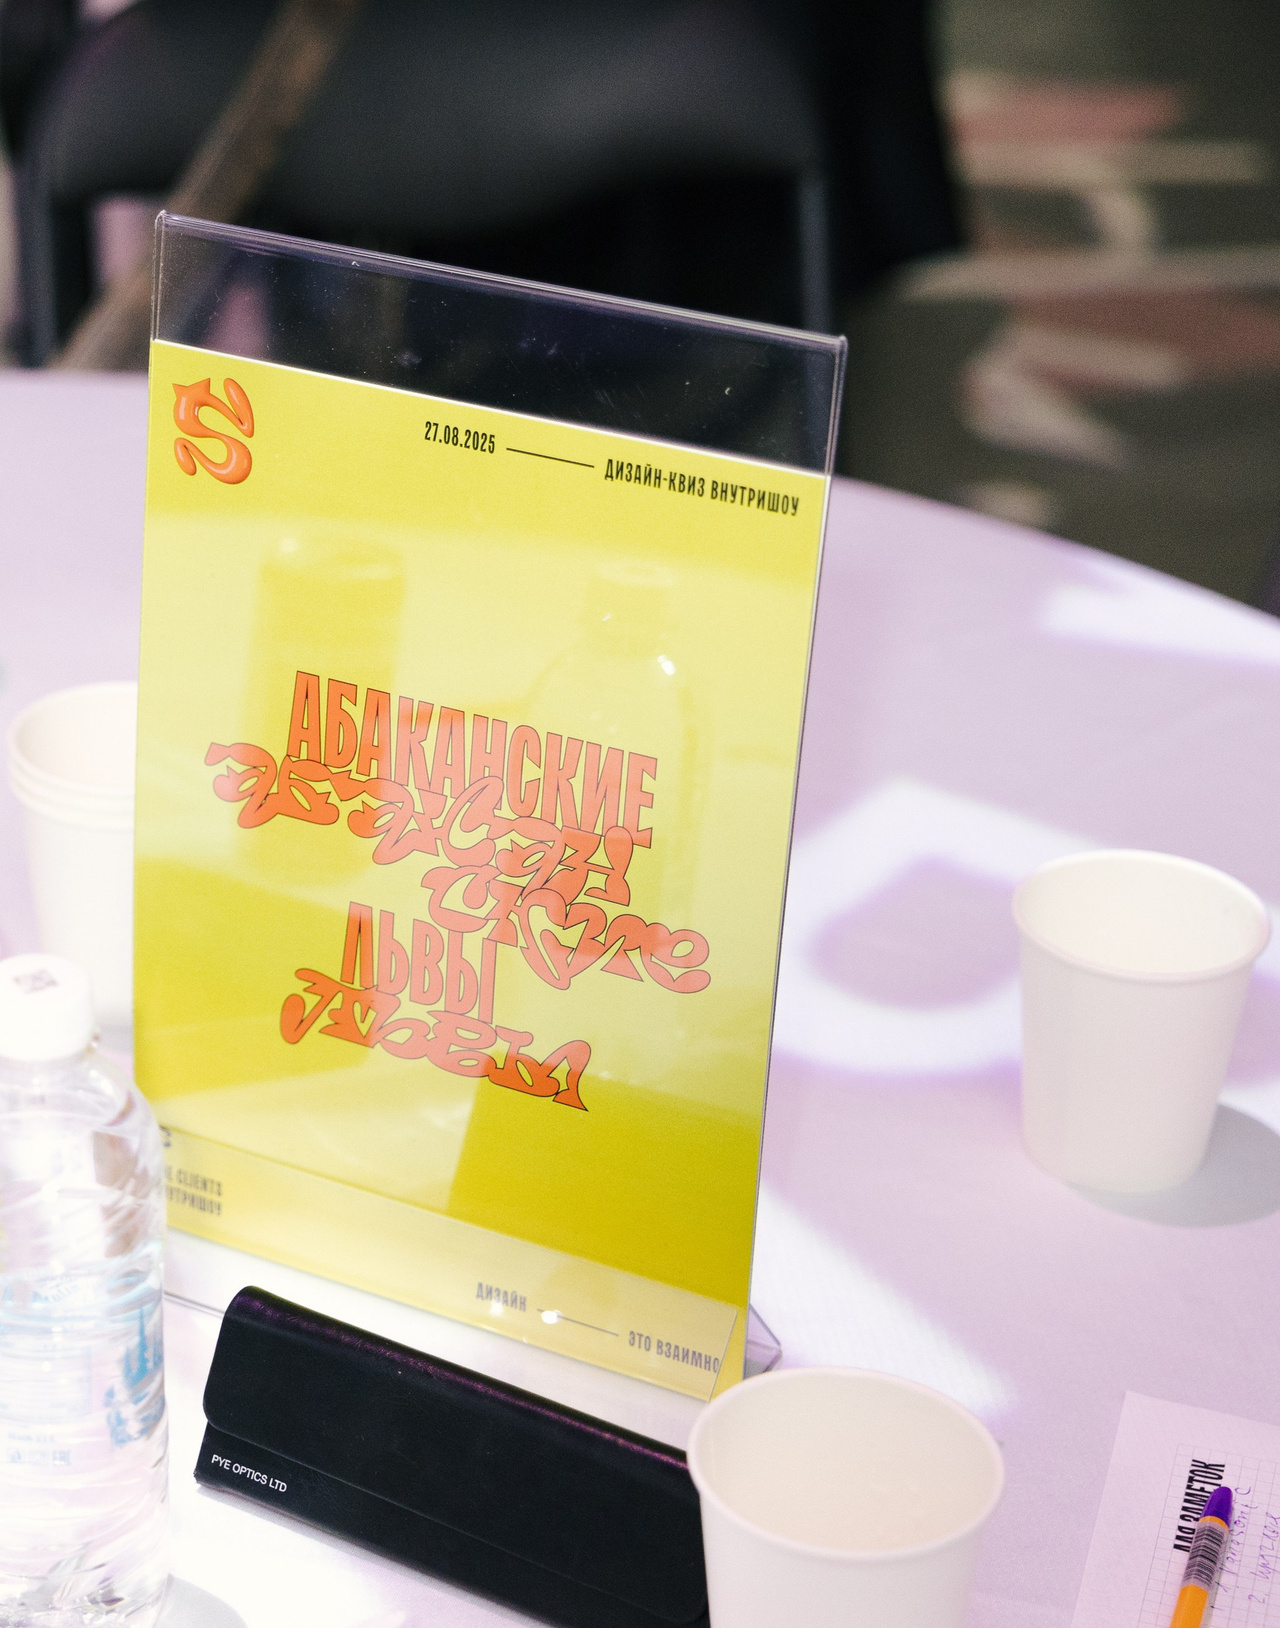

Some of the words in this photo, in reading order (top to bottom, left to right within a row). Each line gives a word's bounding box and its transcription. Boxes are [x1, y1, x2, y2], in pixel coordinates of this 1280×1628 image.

[424, 421, 496, 454] 27.08.2025
[604, 458, 706, 499] ДИЗАЙН-КВИЗ
[710, 480, 800, 517] ВНУТРИШОУ
[286, 671, 658, 849] АБАКАНСКИЕ
[340, 901, 498, 1025] ЛЬВЫ
[476, 1282, 527, 1312] ДИЗАЙН
[628, 1330, 652, 1352] ЭТО
[211, 1454, 231, 1470] PYE
[232, 1463, 268, 1485] OPTICS
[269, 1477, 287, 1492] LTD
